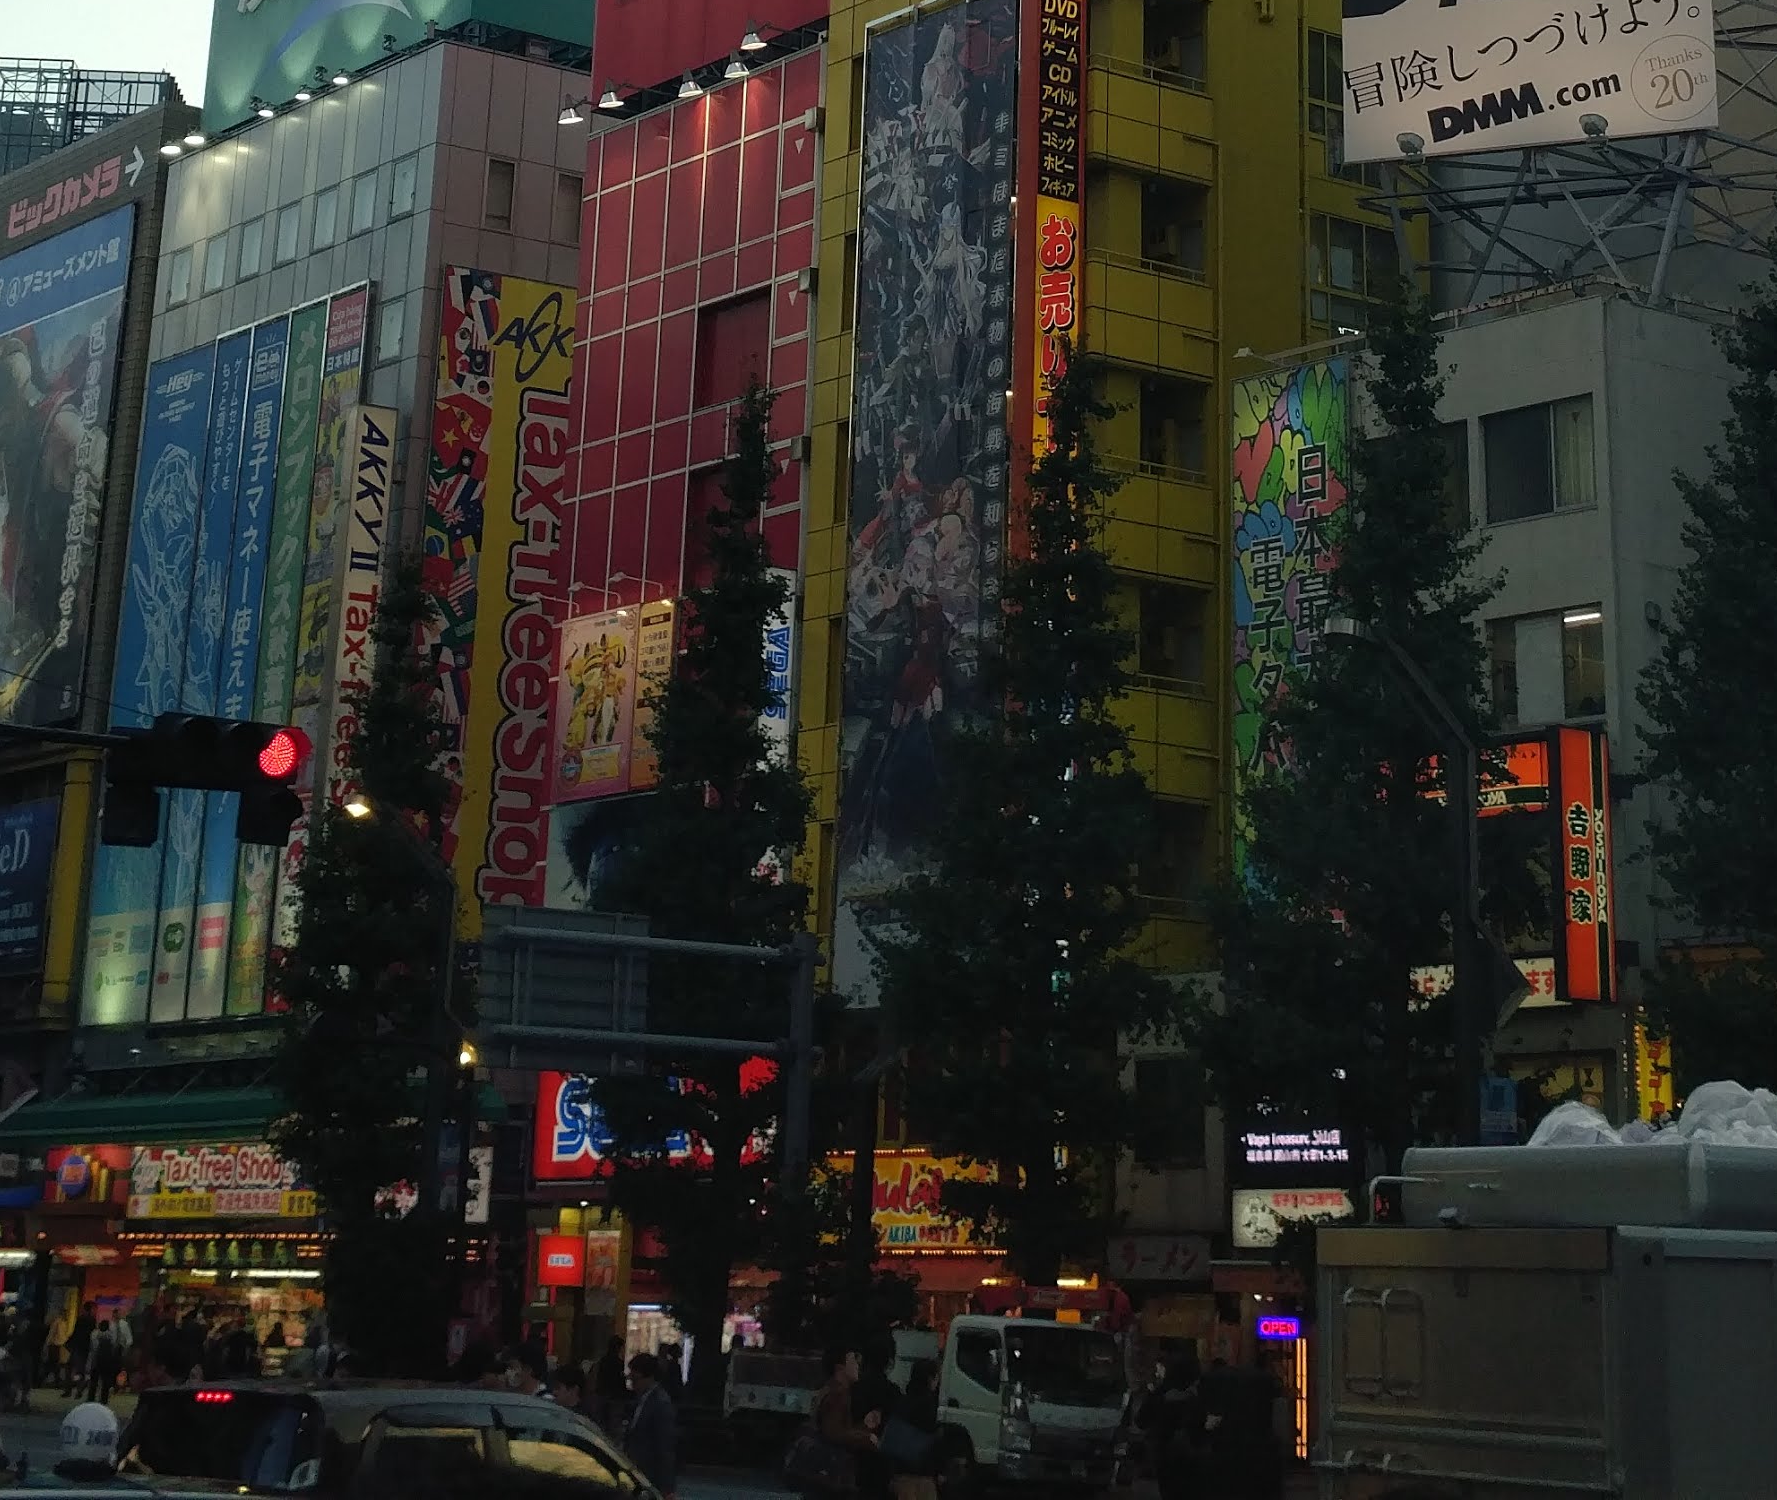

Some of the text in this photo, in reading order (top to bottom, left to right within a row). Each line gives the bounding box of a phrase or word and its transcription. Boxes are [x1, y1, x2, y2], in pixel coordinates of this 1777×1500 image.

[1041, 18, 1080, 42] ブルーレイ
[1041, 41, 1079, 65] ゲーム
[1644, 49, 1703, 73] Thanks
[1047, 63, 1072, 85] CD
[1042, 85, 1079, 108] アイドル
[1649, 65, 1709, 111] 20th
[1426, 69, 1623, 143] DMM.com
[1039, 108, 1078, 131] アニメ
[1041, 131, 1076, 154] コミック
[1042, 152, 1075, 174] ホビー
[6, 154, 123, 239] ビックカメラ
[1041, 175, 1075, 199] フィギュア
[492, 320, 575, 358] AKK
[221, 357, 244, 492] ゲームセンターを
[356, 412, 391, 546] AKKY
[1566, 800, 1592, 926] 吉野家
[1593, 808, 1608, 923] YOSHINOYA
[1118, 1241, 1198, 1276] ラーメン
[1260, 1320, 1297, 1335] OPEN
